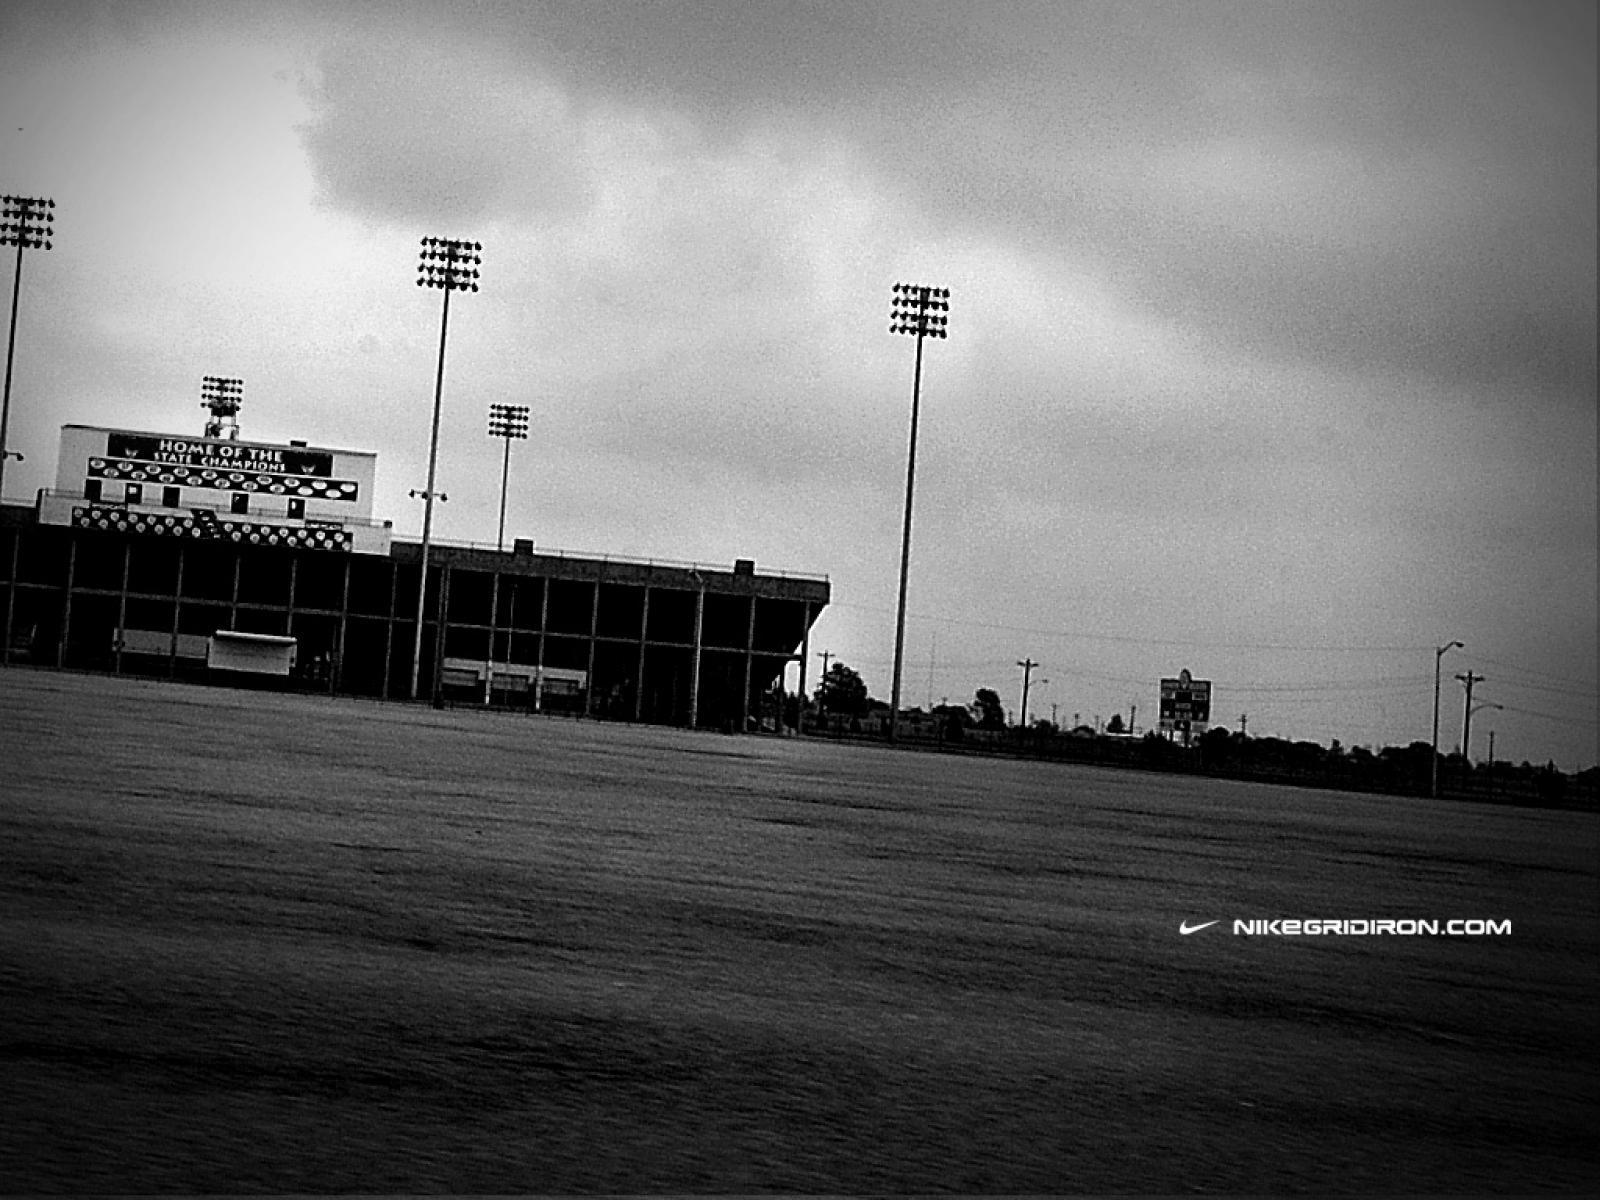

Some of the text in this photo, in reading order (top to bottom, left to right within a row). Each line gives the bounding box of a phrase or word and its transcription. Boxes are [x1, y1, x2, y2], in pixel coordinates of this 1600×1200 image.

[154, 452, 285, 472] STATE CHAMPIONS
[160, 440, 283, 463] HOME OF THE
